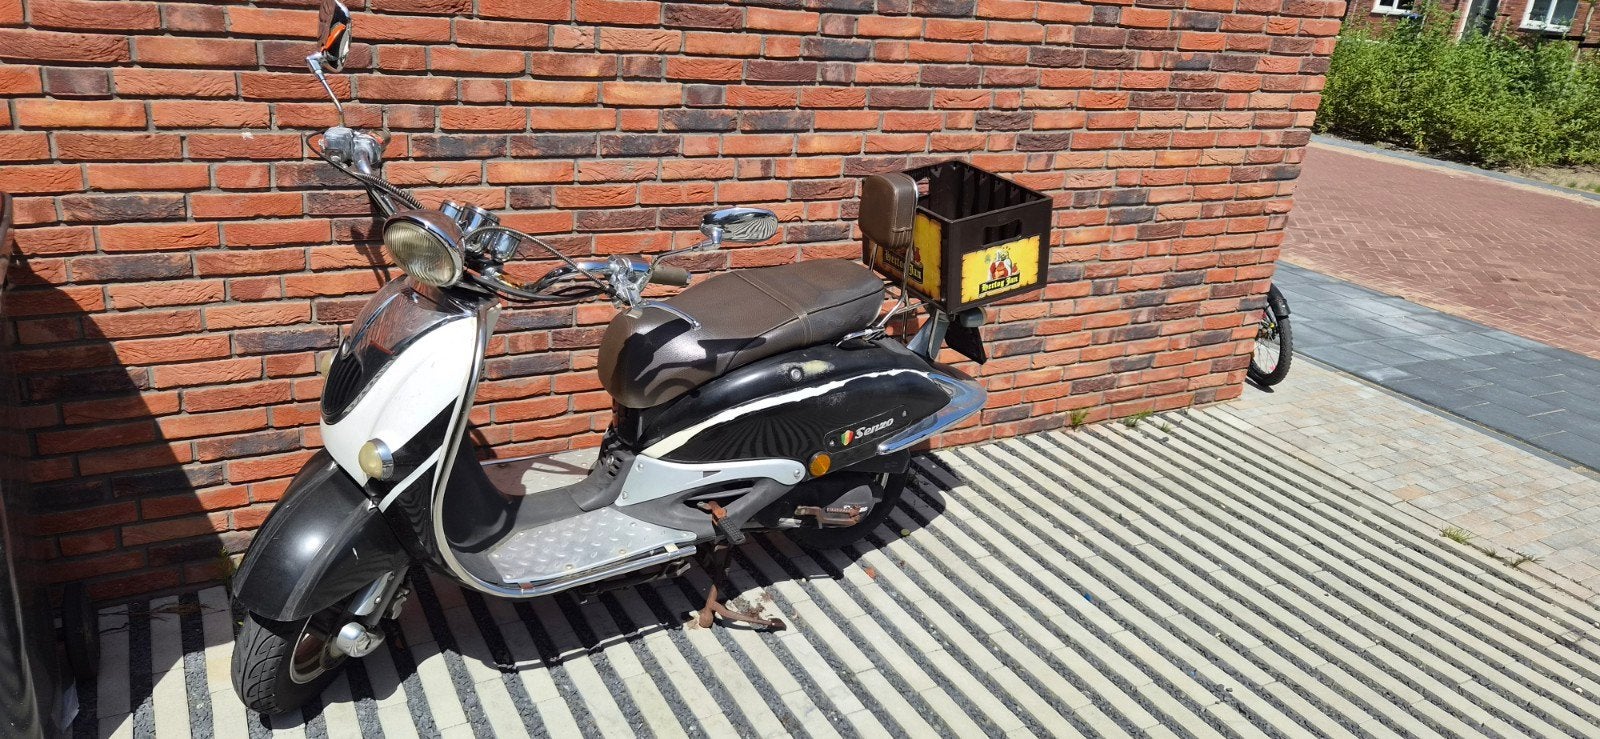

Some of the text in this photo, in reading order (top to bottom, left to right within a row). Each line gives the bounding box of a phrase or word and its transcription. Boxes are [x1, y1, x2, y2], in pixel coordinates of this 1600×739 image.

[885, 250, 907, 270] Herto
[981, 275, 1019, 292] Hertog Jan
[854, 417, 894, 439] Senzo
